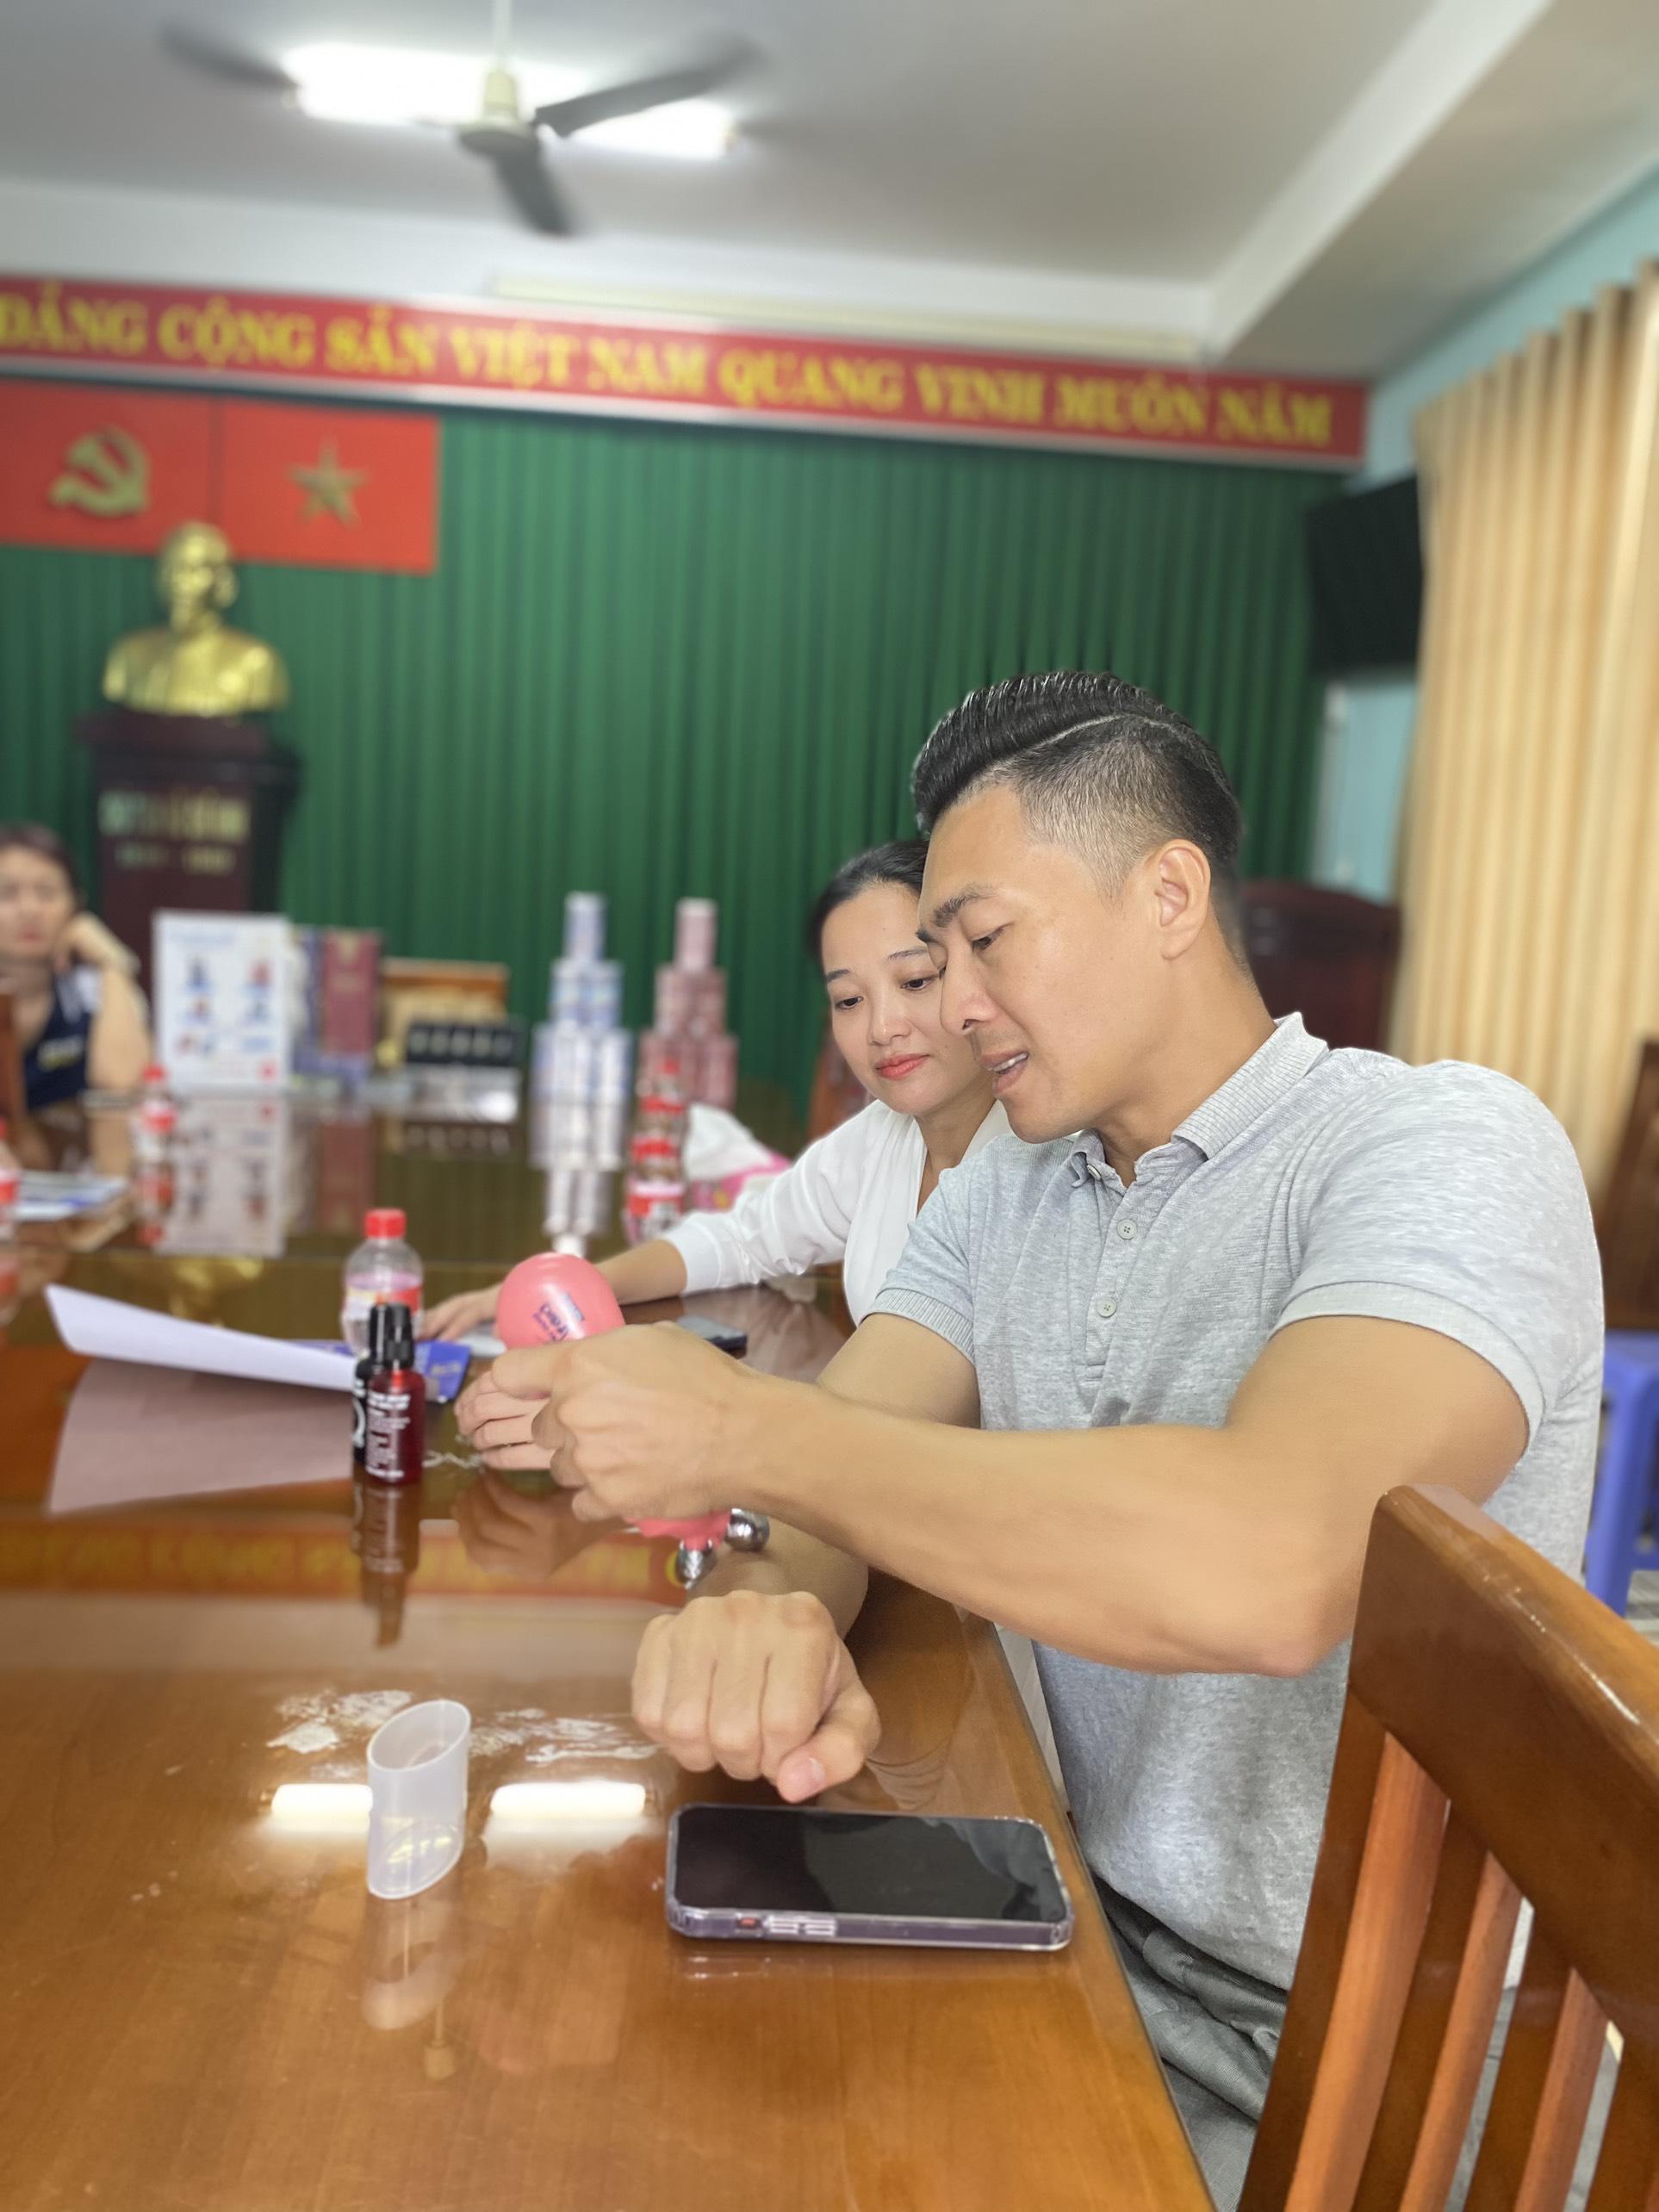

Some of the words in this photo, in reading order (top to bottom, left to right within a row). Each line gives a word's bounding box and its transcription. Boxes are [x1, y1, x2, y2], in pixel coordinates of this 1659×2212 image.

[158, 295, 315, 370] CỘNG
[326, 304, 438, 374] SẢN
[449, 321, 580, 391] VIỆT
[587, 337, 707, 397] NAM
[718, 349, 904, 410] QUANG
[916, 363, 1047, 425] VINH
[1055, 371, 1209, 436] MUÔN
[1218, 383, 1333, 447] NĂM
